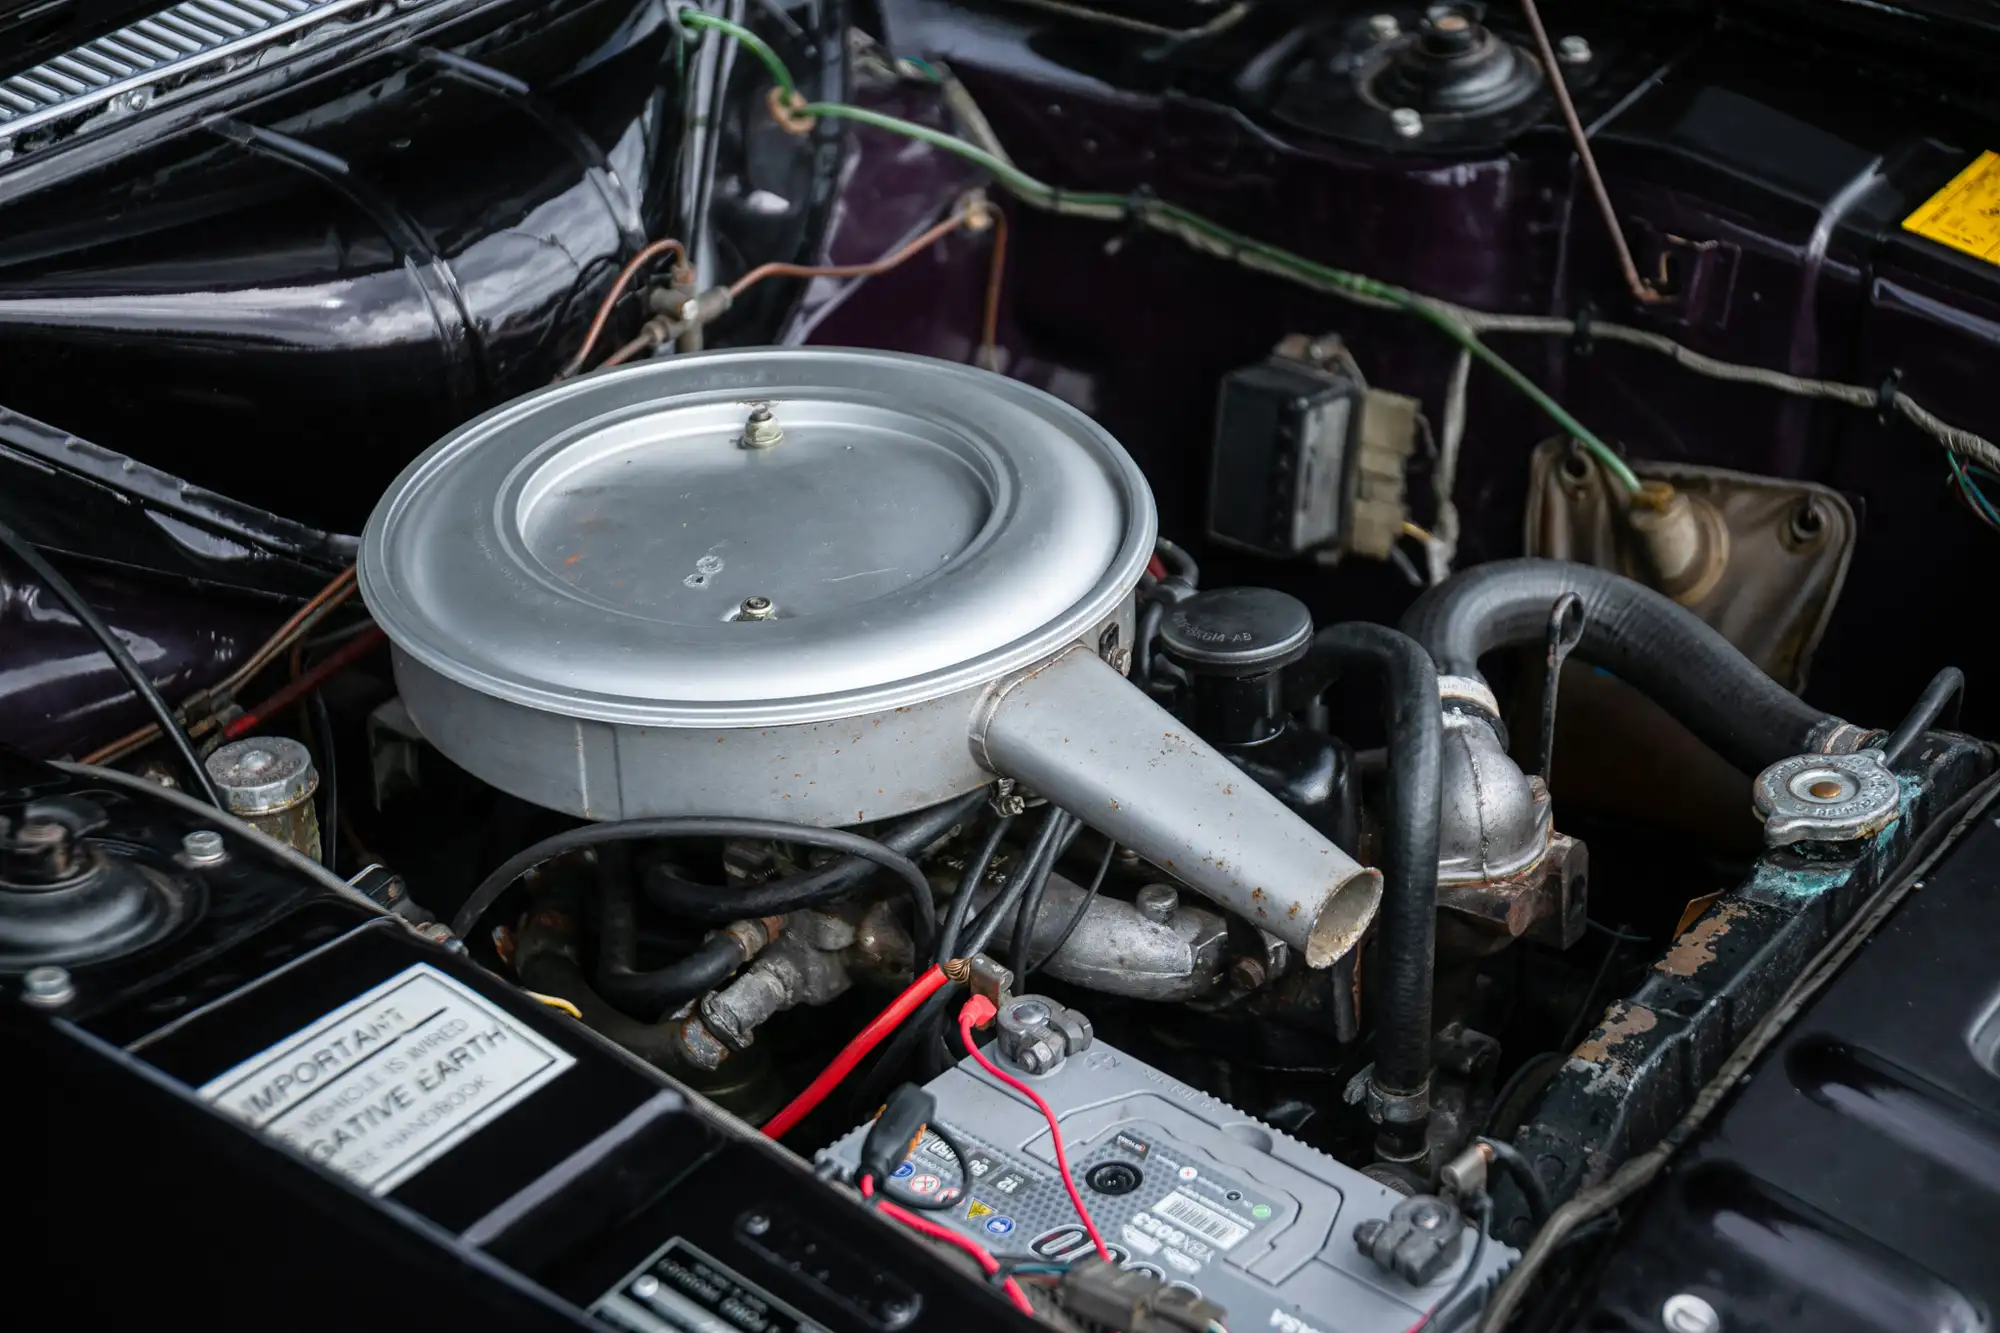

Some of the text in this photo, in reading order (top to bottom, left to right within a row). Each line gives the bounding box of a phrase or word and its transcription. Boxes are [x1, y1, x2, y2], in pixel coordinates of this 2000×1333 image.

[239, 1007, 404, 1117] IMPORTANT
[304, 1024, 507, 1163] GATIVE EARTH
